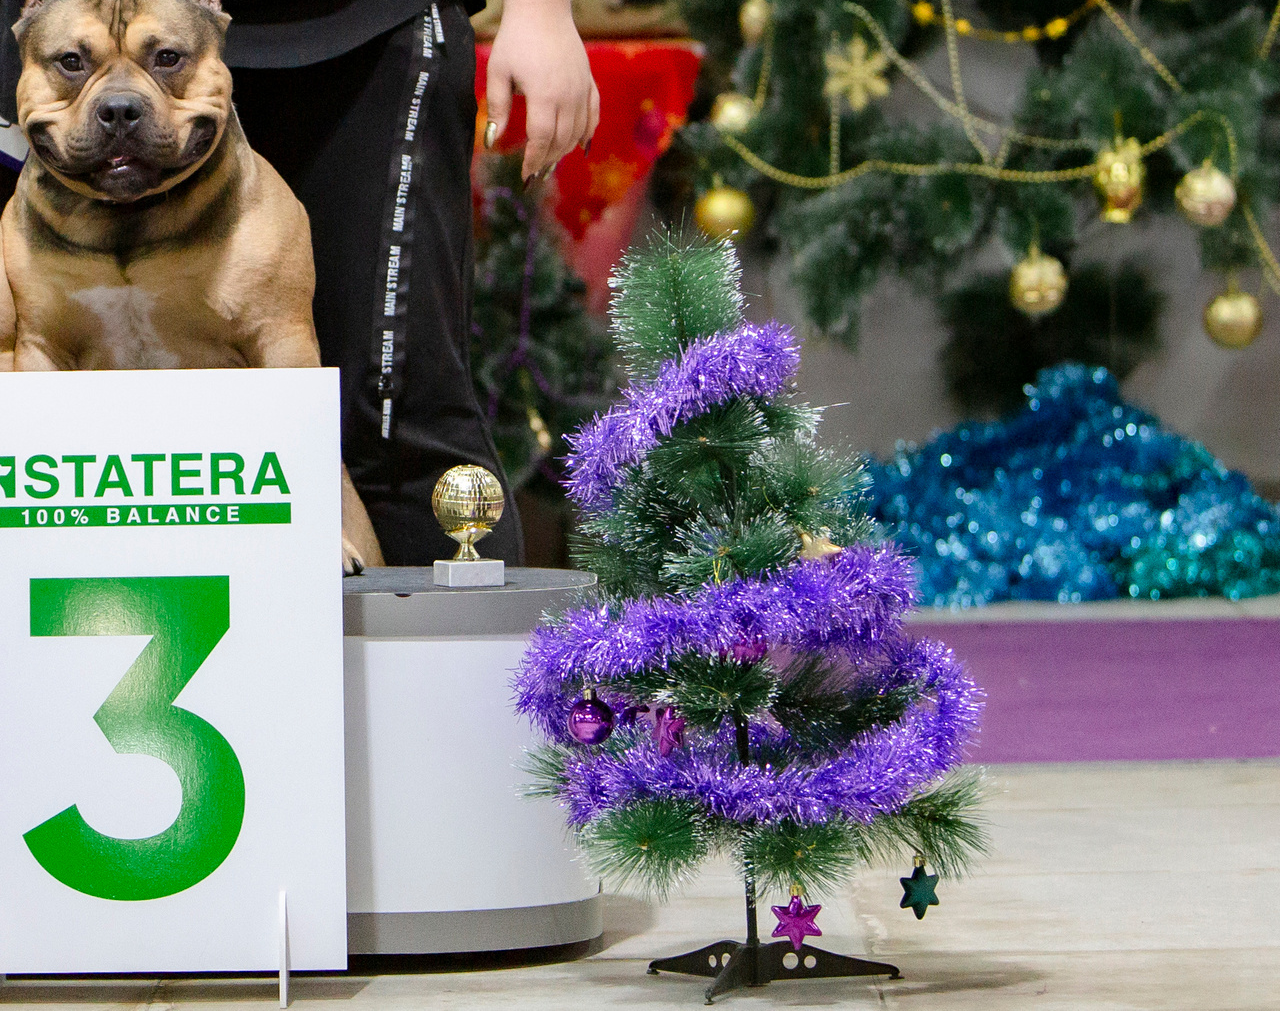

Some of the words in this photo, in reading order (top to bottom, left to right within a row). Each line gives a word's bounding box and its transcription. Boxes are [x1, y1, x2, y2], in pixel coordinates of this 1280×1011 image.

[422, 15, 433, 59] STREAM
[414, 71, 430, 96] MAIN
[404, 97, 422, 141] STREAM
[392, 206, 406, 232] MAIN
[386, 245, 401, 289] STREAM
[383, 291, 397, 317] MAIN
[381, 330, 394, 374] STREAM
[23, 451, 291, 500] STATERA
[21, 508, 90, 526] 100%
[106, 505, 241, 524] BALANCE
[22, 575, 246, 902] 3
